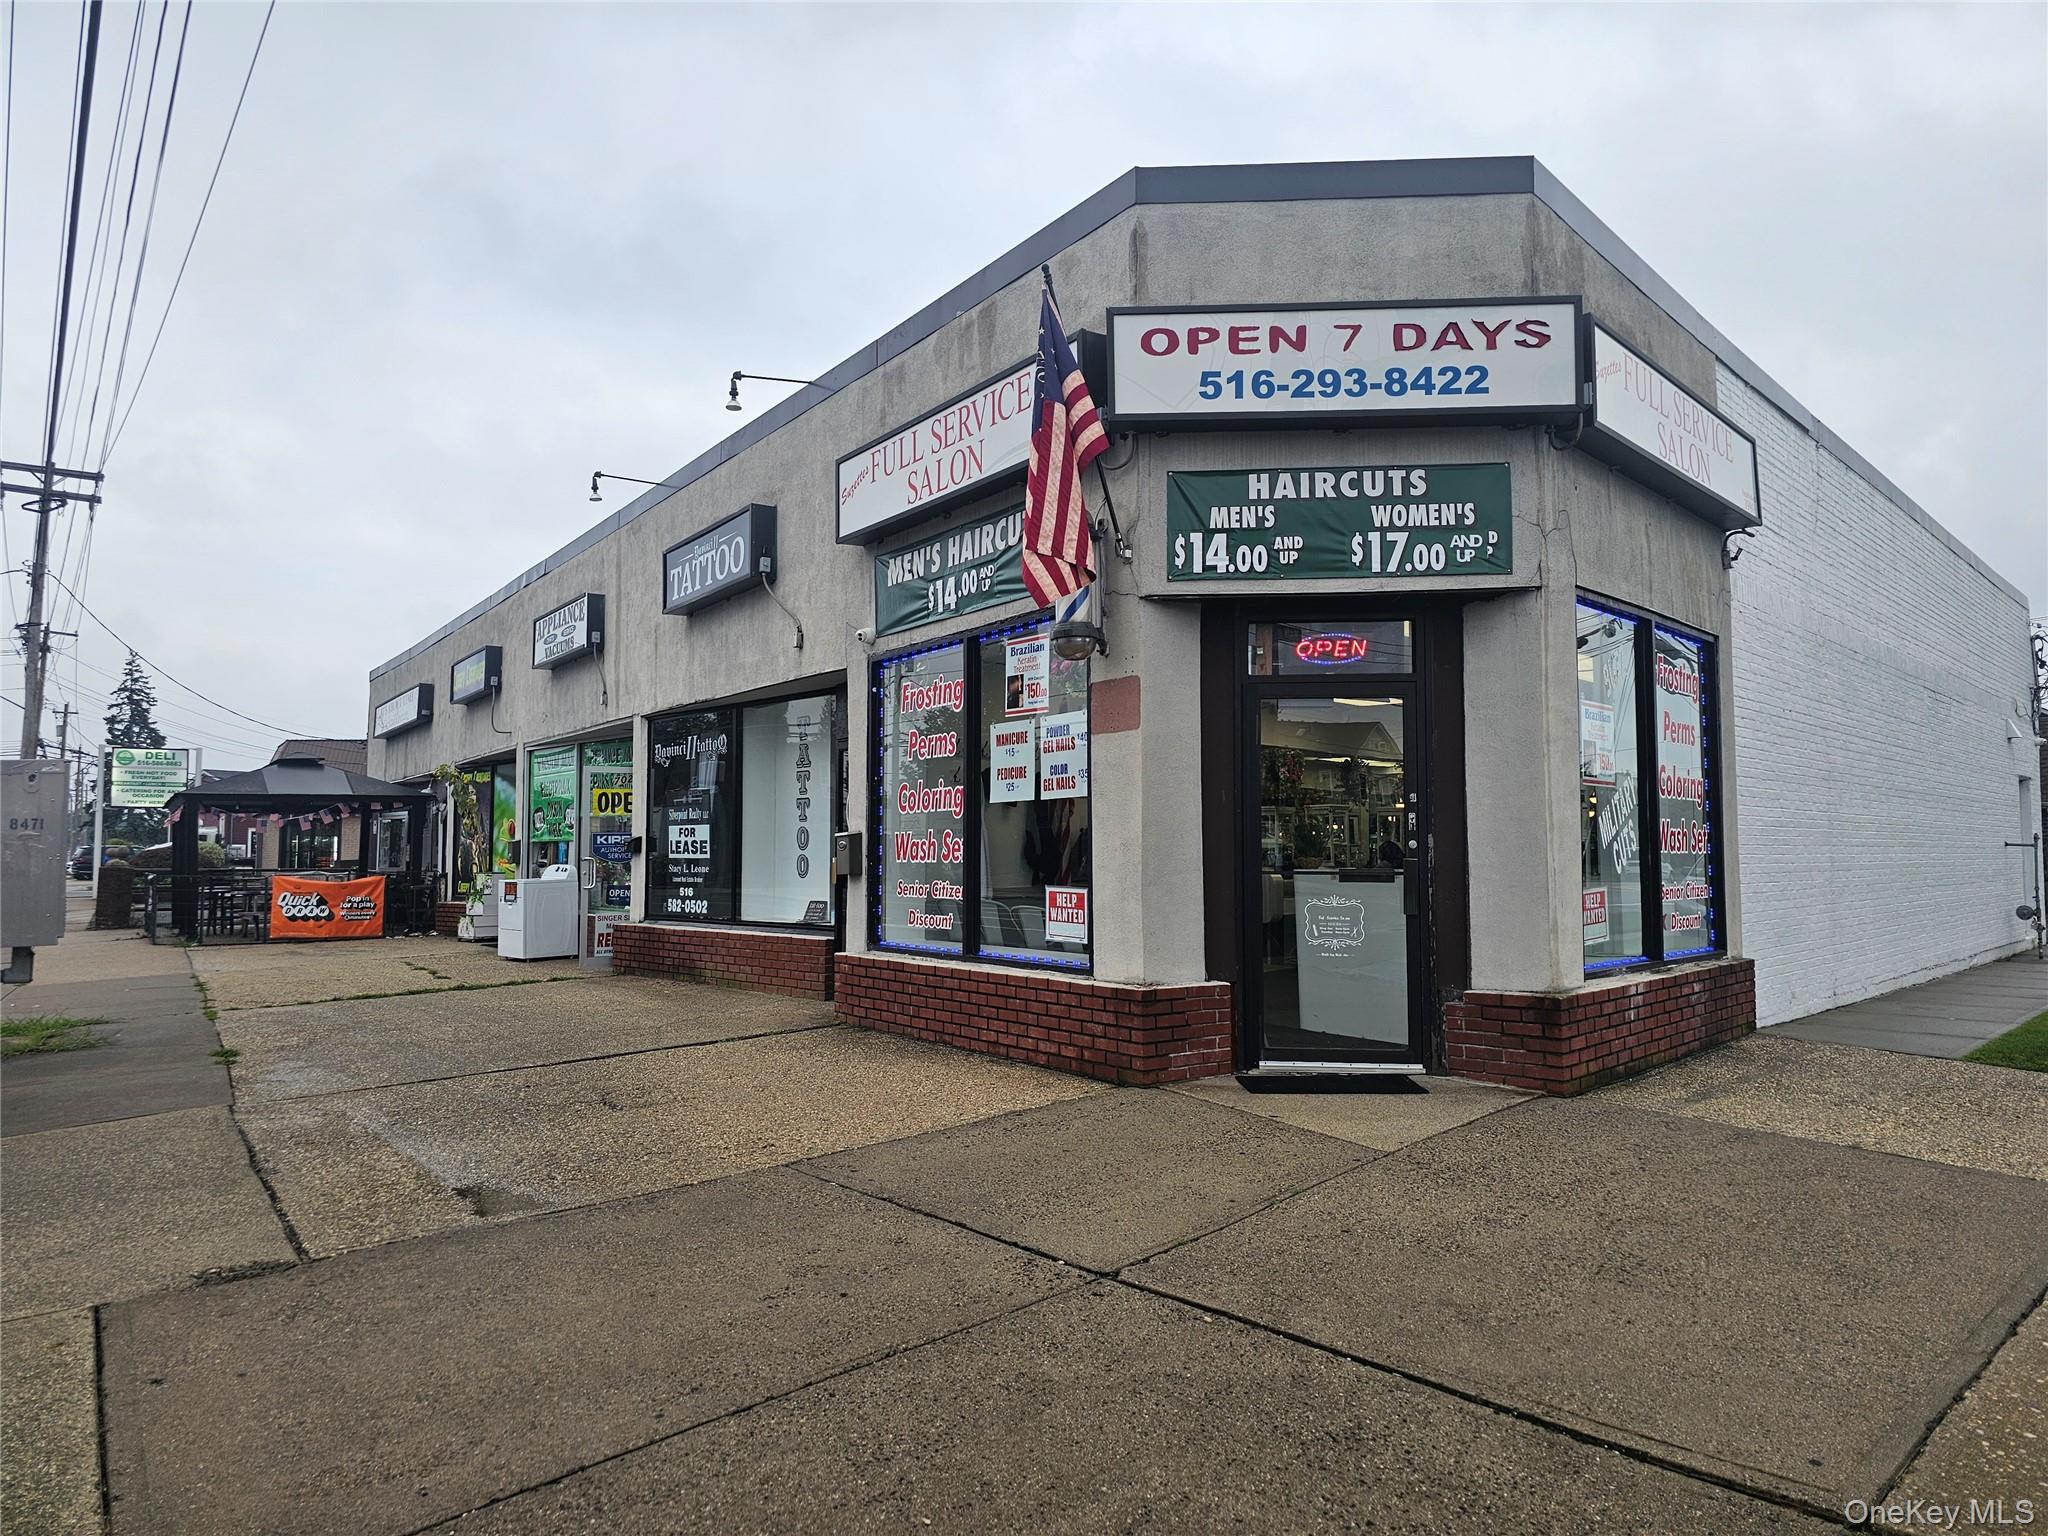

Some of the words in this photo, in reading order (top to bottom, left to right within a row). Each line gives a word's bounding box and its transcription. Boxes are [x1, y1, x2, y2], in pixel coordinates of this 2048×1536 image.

[1140, 324, 1307, 357] OPEN
[1333, 323, 1363, 352] 7
[1392, 318, 1552, 352] DAYS
[1198, 365, 1490, 400] 516-293-8422
[1623, 352, 1669, 419] FULL
[1673, 390, 1733, 464] SERVICE
[870, 429, 925, 484] FULL
[931, 371, 1032, 456] SERVICE
[1657, 421, 1711, 486] SALON
[907, 438, 985, 505] SALON
[1248, 468, 1427, 499] HAIRCUTS
[1209, 505, 1275, 529] MEN'S
[1370, 502, 1475, 527] WOMEN'S
[887, 542, 941, 587] MEN'S
[947, 510, 1026, 568] HAIRCU
[1174, 532, 1268, 574] $14.00
[1273, 536, 1304, 550] AND
[1279, 551, 1299, 564] UP
[1351, 531, 1446, 573] $17.00
[1450, 534, 1483, 548] AND
[1456, 549, 1476, 562] UP
[670, 536, 745, 600] TATTOO
[928, 569, 978, 613] $14.00
[978, 564, 995, 580] AND
[981, 578, 992, 592] UP
[536, 599, 585, 643] APPLIANCE
[545, 636, 575, 659] VACUUMS
[1010, 643, 1045, 657] Brazilian
[1296, 639, 1367, 657] OPEN
[1656, 654, 1699, 703] Frosting
[901, 674, 964, 712] Frosting
[1585, 708, 1611, 724] Brazilian
[1046, 724, 1070, 738] POWDER
[1663, 710, 1696, 747] Perms
[908, 729, 957, 760] Perms
[996, 731, 1028, 747] MANICURE
[1043, 740, 1054, 754] GEL
[1055, 736, 1076, 752] NAILS
[145, 751, 176, 760] DELI
[1005, 748, 1015, 757] $15
[997, 766, 1027, 780] PEDICURE
[1049, 763, 1068, 776] COLOR
[1006, 783, 1015, 792] $25
[1043, 778, 1054, 792] GEL
[1055, 775, 1076, 790] NAILS
[1658, 764, 1703, 810] Coloring
[597, 791, 632, 813] OPE
[796, 715, 811, 879] TATTOO
[898, 778, 964, 819] Coloring
[9, 818, 44, 830] 8471
[679, 828, 696, 838] FOR
[894, 829, 938, 863] Wash
[941, 829, 963, 863] Se
[1613, 819, 1637, 875] CUTS
[1691, 820, 1708, 854] Set
[670, 840, 708, 855] LEASE
[668, 864, 681, 874] Stacy
[683, 864, 689, 872] L.
[691, 864, 709, 873] Leone
[277, 892, 320, 906] Quick
[609, 889, 630, 897] OPEN
[680, 887, 694, 896] 516
[897, 879, 929, 899] Senior
[931, 880, 963, 900] Citize
[1661, 881, 1684, 901] Senior
[1685, 881, 1708, 899] Citizen
[667, 899, 708, 913] 582-0502
[1056, 893, 1077, 907] HELP
[1585, 892, 1600, 908] HELP
[284, 906, 329, 916] DRAW
[908, 909, 953, 930] Discount
[1050, 907, 1084, 923] WANTED
[1670, 912, 1701, 931] Discount
